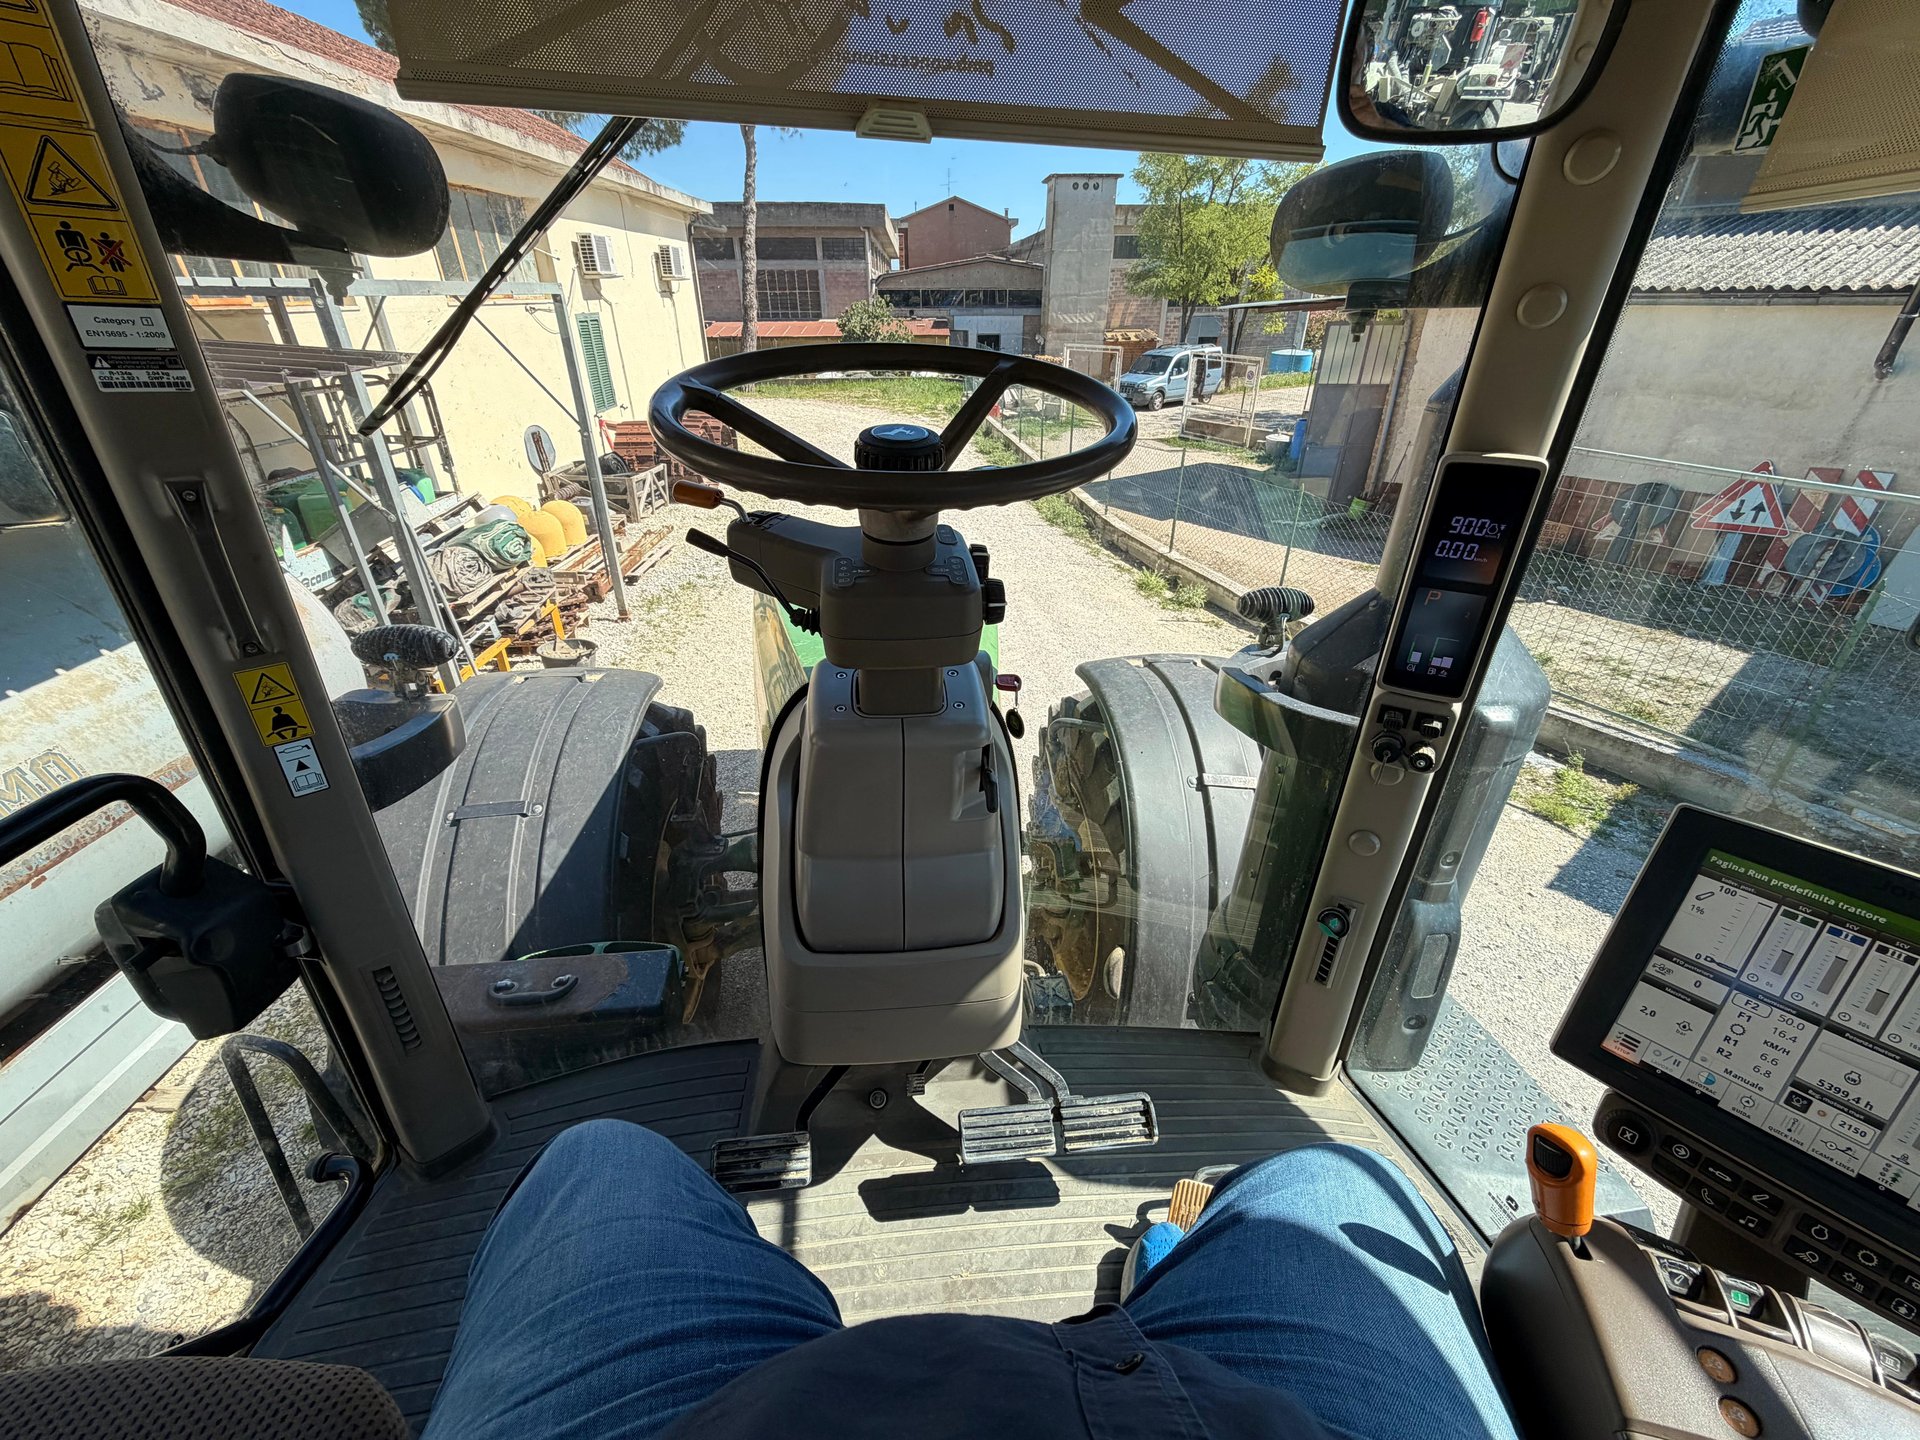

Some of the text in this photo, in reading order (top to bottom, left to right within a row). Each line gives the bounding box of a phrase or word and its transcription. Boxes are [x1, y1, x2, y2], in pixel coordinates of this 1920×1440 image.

[94, 316, 136, 326] Category
[86, 329, 128, 338] EN15695
[136, 331, 166, 339] 1:2009
[1449, 516, 1490, 537] 900
[1435, 540, 1479, 560] 0.00
[1424, 590, 1442, 606] P
[1710, 855, 1888, 924] Pagina Run predefinita trattore
[1719, 885, 1738, 897] 100
[1690, 903, 1705, 916] 1%
[1799, 905, 1812, 913] SCV
[1846, 922, 1860, 931] SCV
[1895, 941, 1910, 950] SCV
[1694, 953, 1702, 961] 0
[1693, 980, 1702, 988] 0
[1744, 999, 1805, 1031] F2 50.0
[1675, 1028, 1686, 1036] bar
[1737, 1011, 1798, 1044] F1 16.4
[1723, 1035, 1780, 1066] R1 6.6
[1763, 1039, 1791, 1056] KM/H
[1716, 1047, 1772, 1078] R2 6.8
[1687, 1077, 1718, 1095] AUTOTRAC
[1723, 1068, 1764, 1092] Manuale
[1731, 1106, 1751, 1119] GUIDA
[1864, 1100, 1874, 1111] h
[1767, 1125, 1805, 1147] QUICK LINE
[1838, 1120, 1868, 1138] 2150
[1835, 1159, 1855, 1174] LINEA
